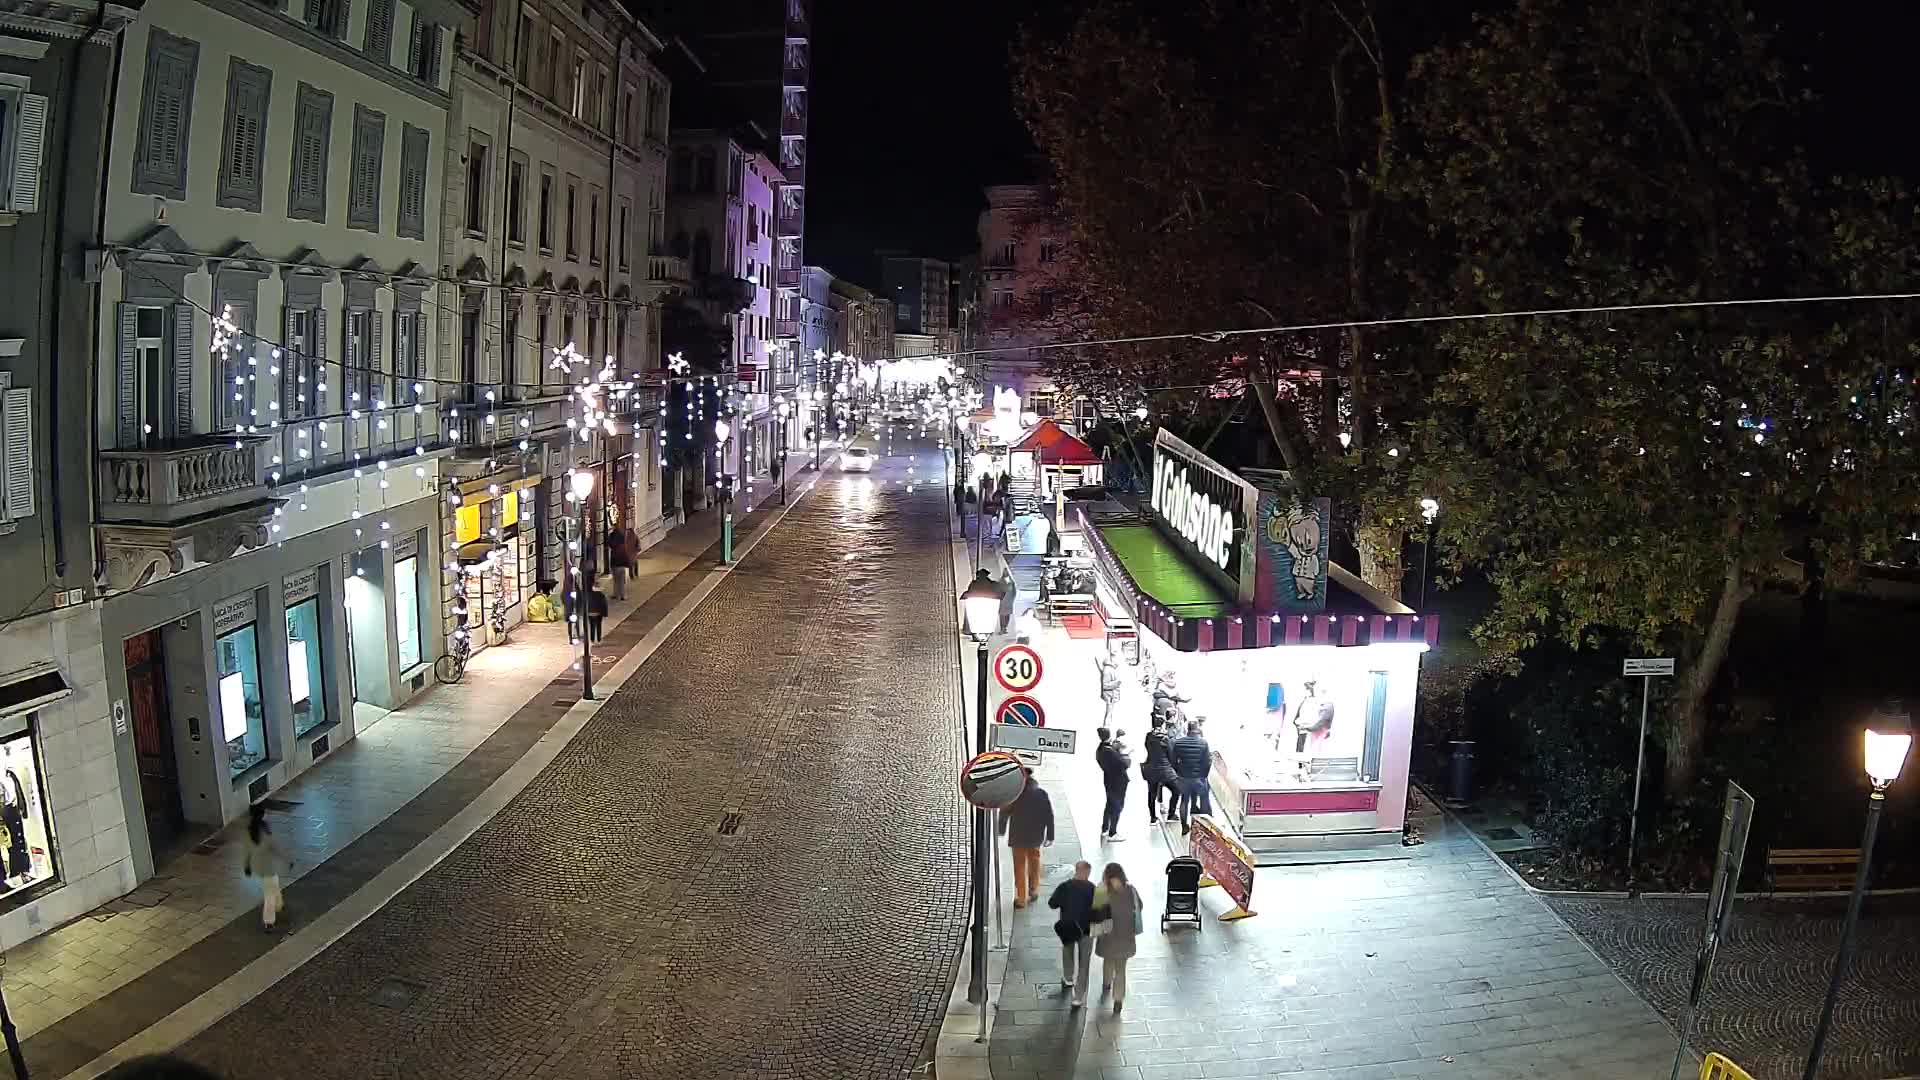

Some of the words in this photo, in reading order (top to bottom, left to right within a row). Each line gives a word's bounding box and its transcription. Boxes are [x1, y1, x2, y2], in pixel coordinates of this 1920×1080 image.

[1162, 458, 1233, 570] Golosone
[1006, 658, 1032, 680] 30
[1038, 737, 1070, 749] Dante
